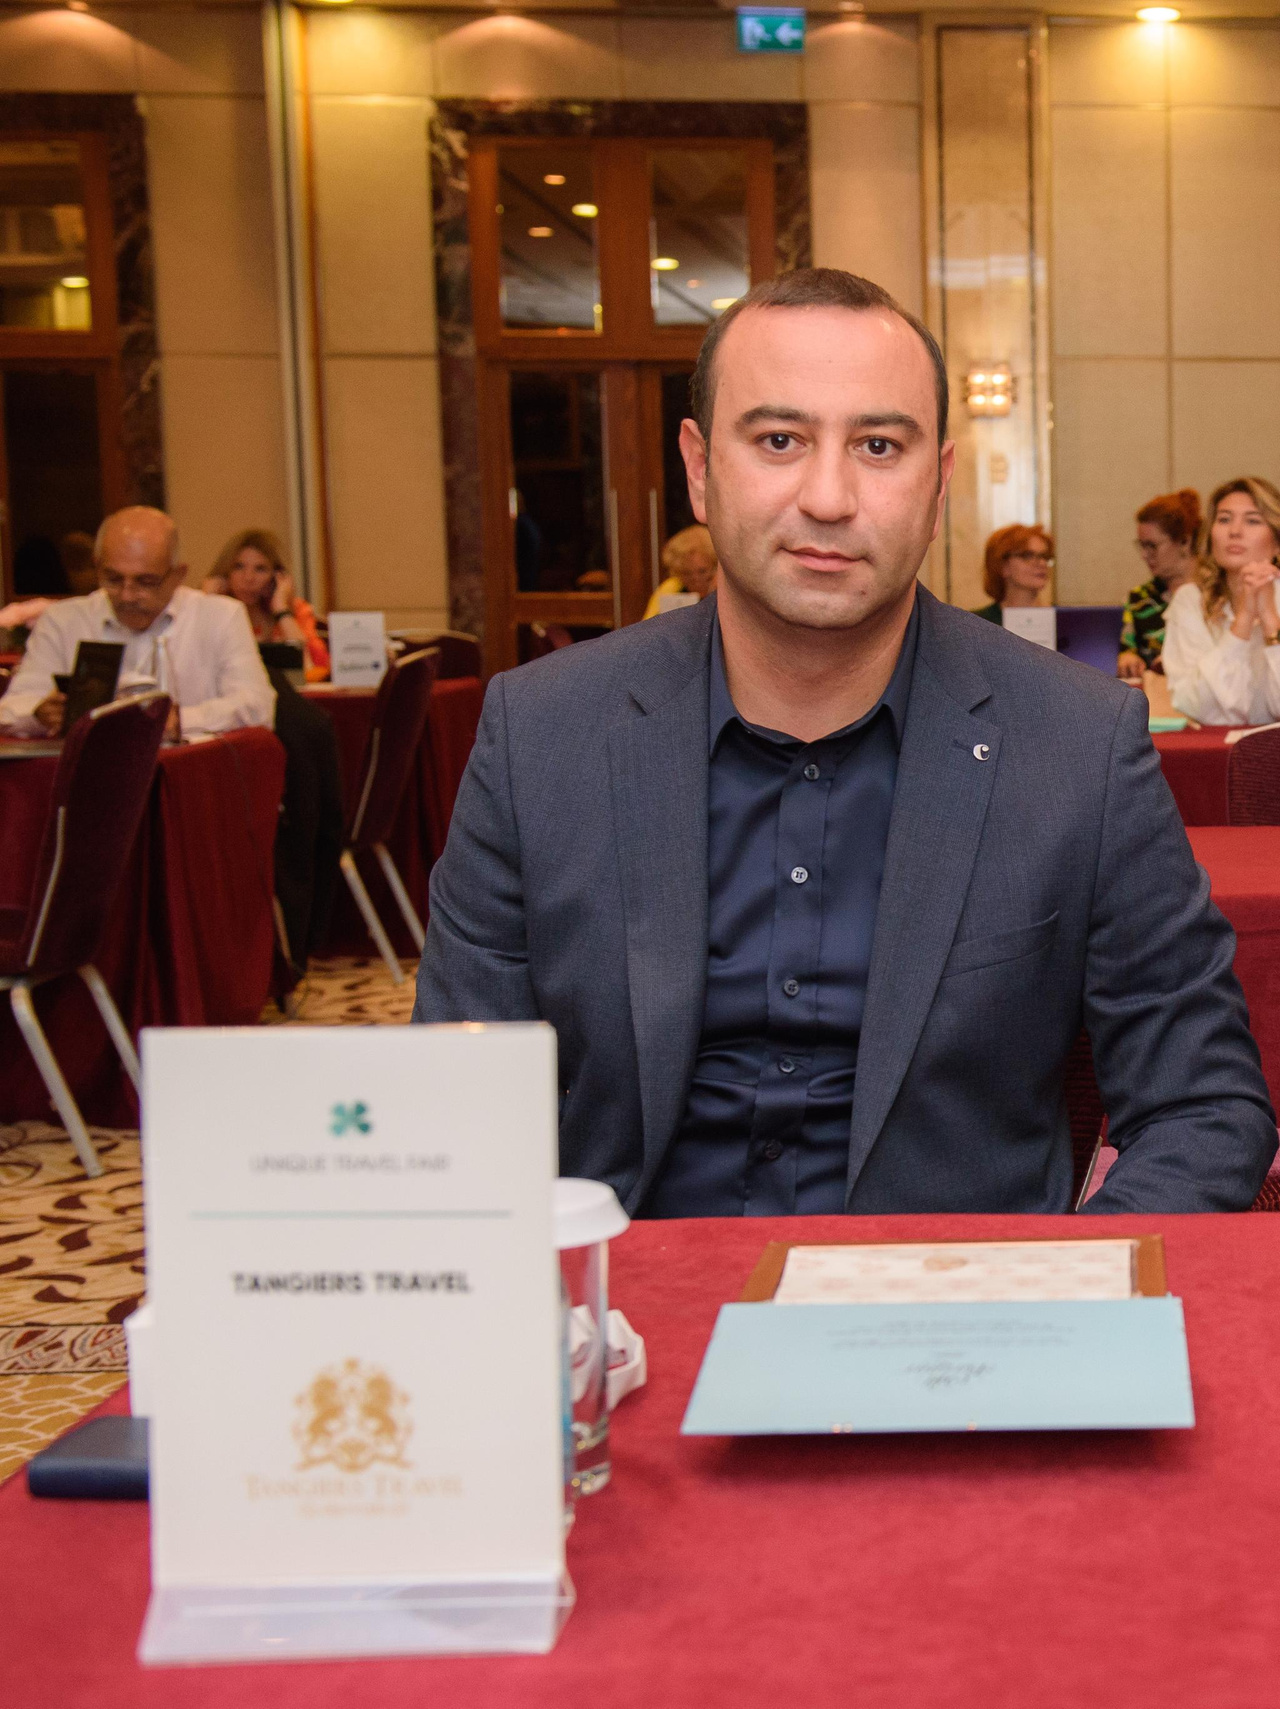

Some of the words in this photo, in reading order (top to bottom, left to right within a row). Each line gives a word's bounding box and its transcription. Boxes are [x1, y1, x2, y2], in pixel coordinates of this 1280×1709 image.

[333, 1154, 401, 1172] TRAVEL
[232, 1272, 364, 1295] TANGIERS
[374, 1272, 472, 1295] TRAVEL
